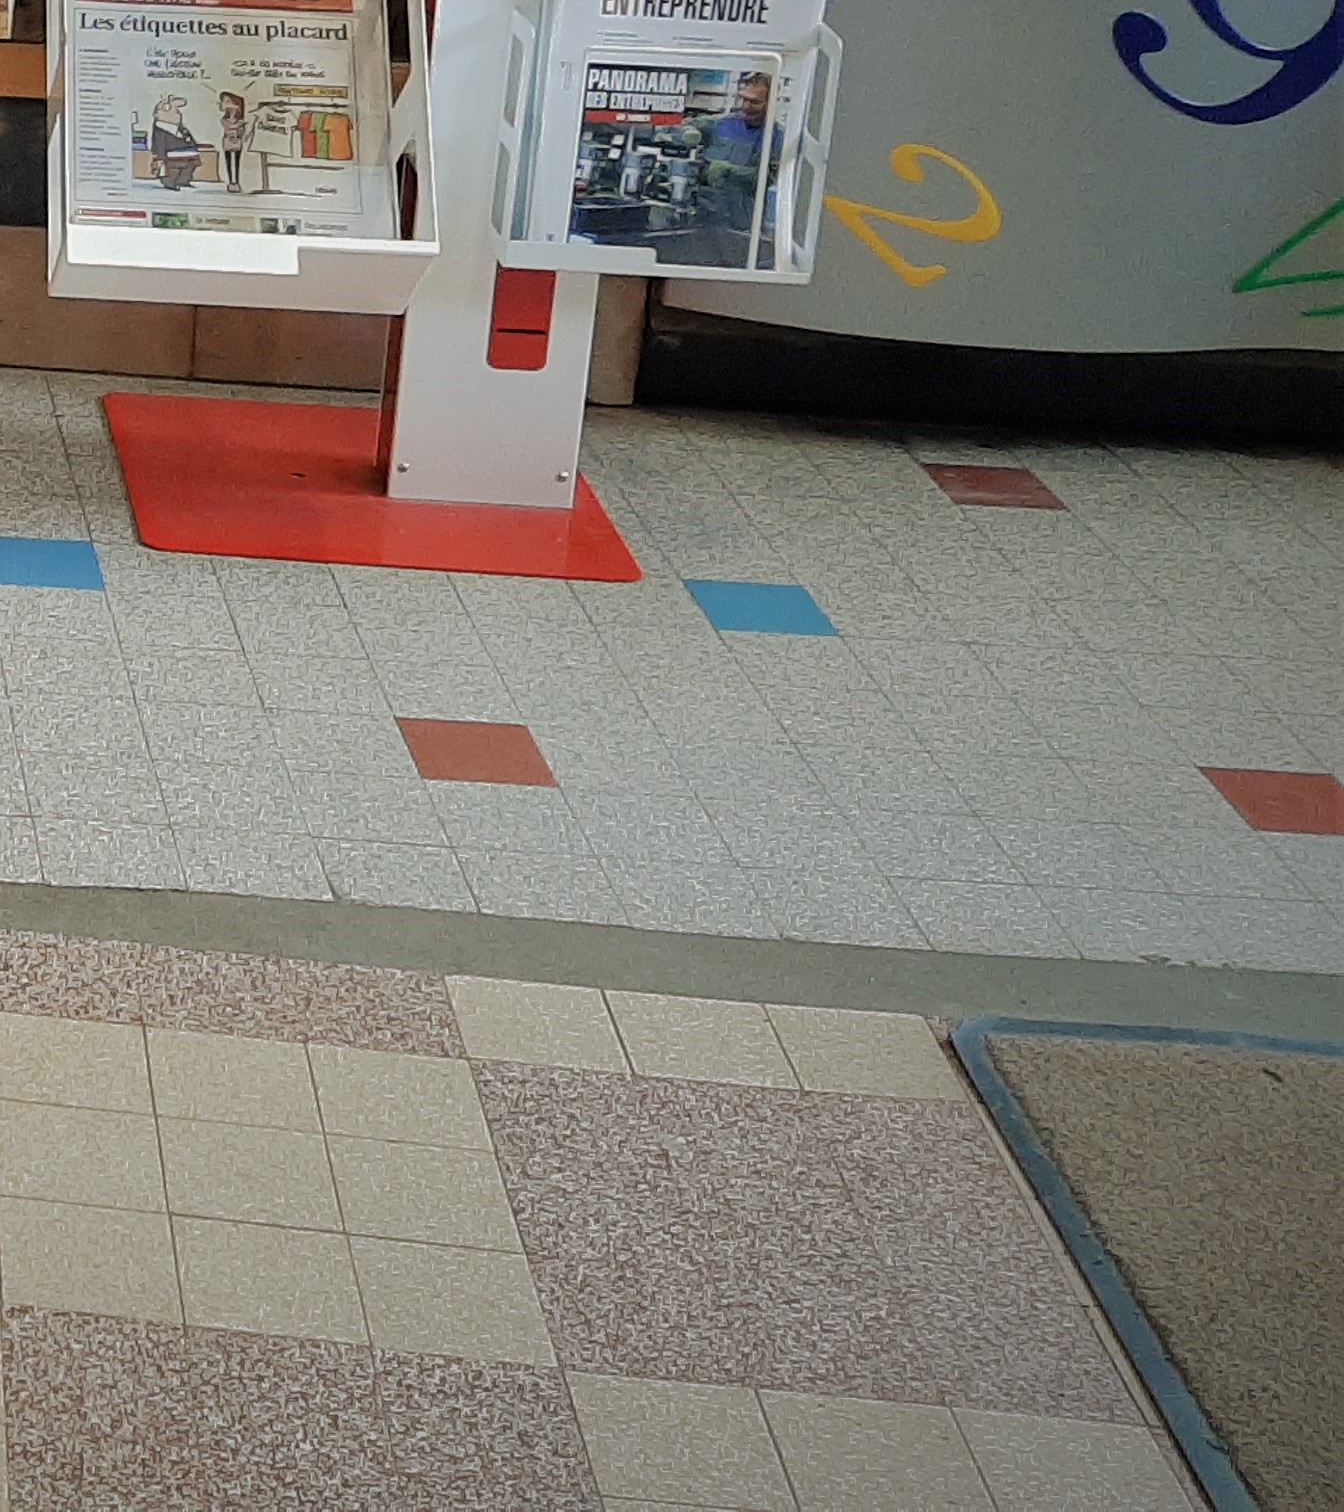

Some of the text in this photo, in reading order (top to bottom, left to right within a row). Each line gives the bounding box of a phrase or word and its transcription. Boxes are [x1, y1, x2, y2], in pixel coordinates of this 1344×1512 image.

[78, 12, 349, 41] Les étiquettes au placard
[587, 68, 689, 95] PANORAMA
[824, 143, 1002, 287] 2
